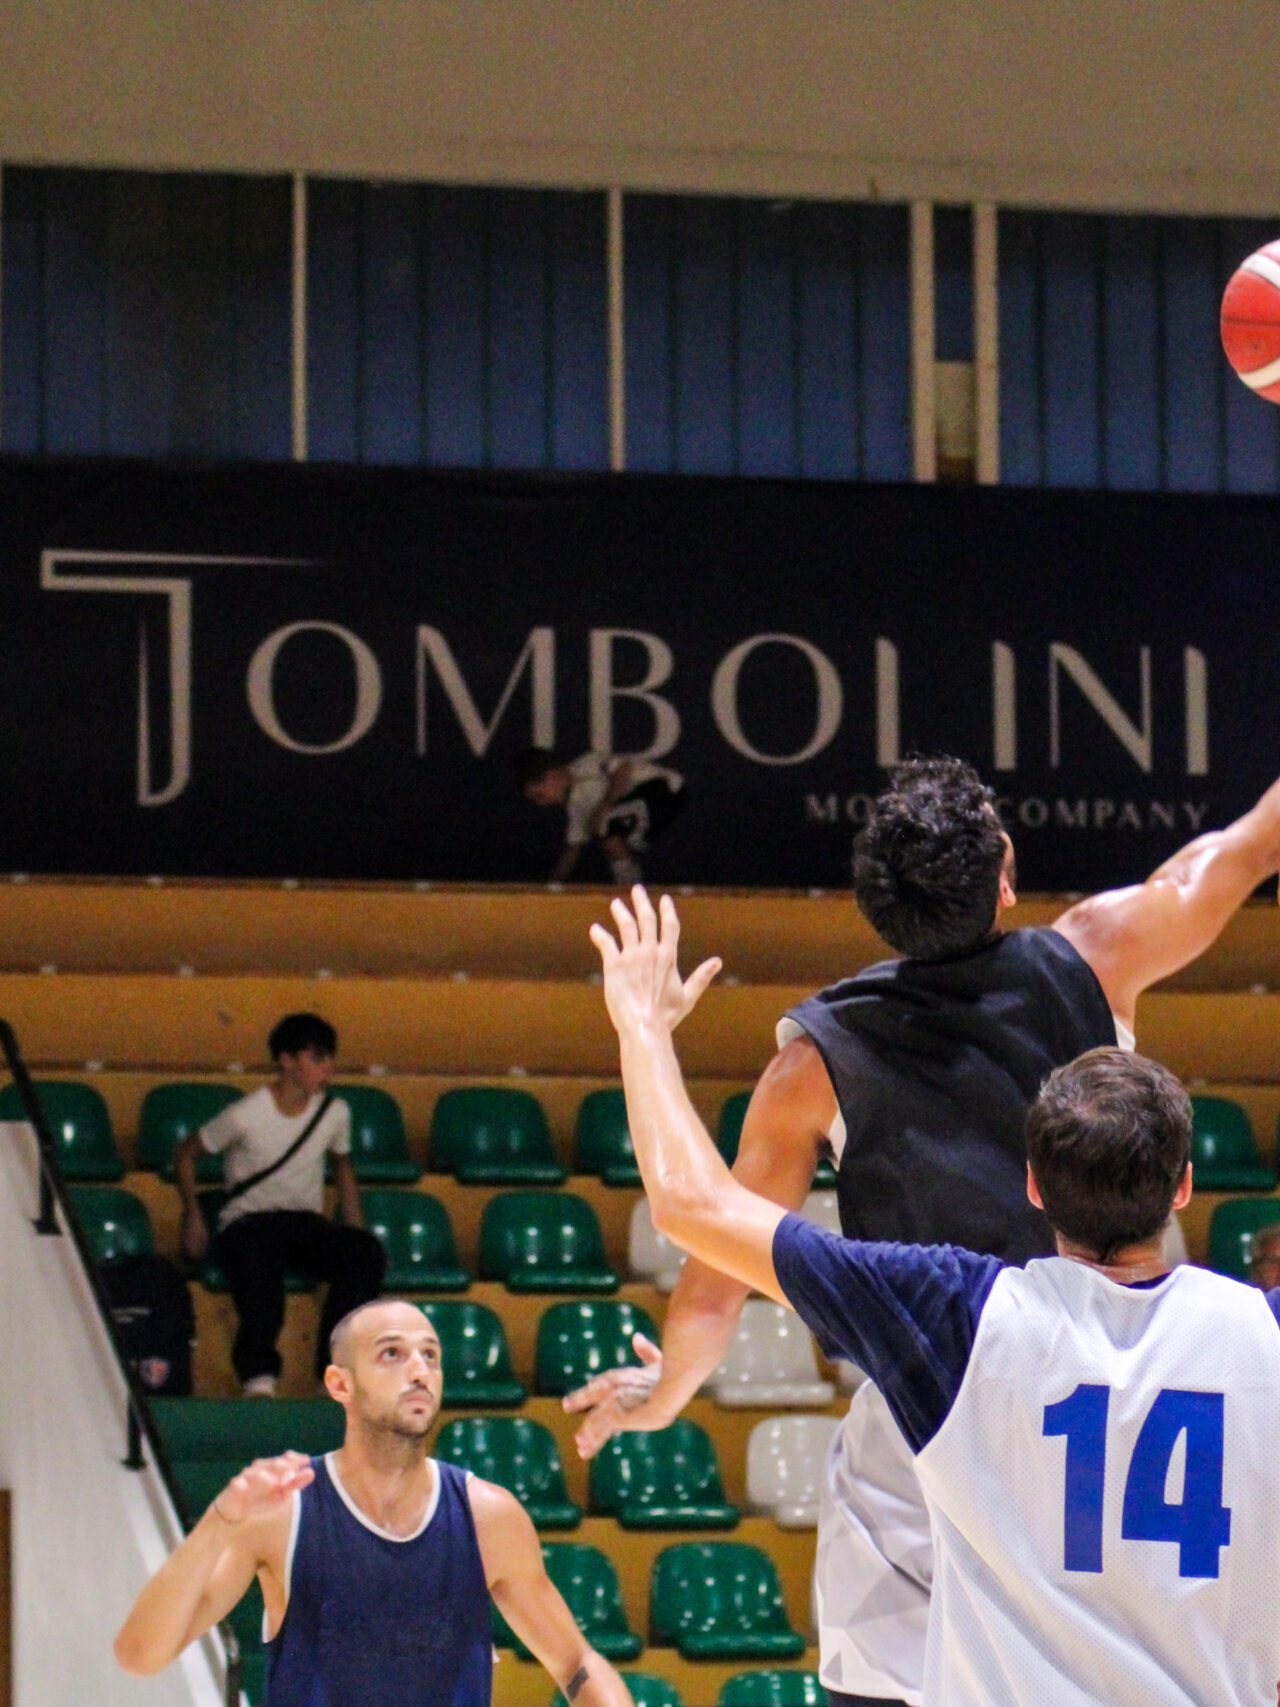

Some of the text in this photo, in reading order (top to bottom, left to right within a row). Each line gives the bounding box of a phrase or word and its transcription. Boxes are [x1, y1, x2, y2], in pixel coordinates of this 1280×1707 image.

[40, 548, 1209, 808] TOMBOLINI
[995, 797, 1208, 829] COMPANY
[1043, 1383, 1231, 1579] 14
